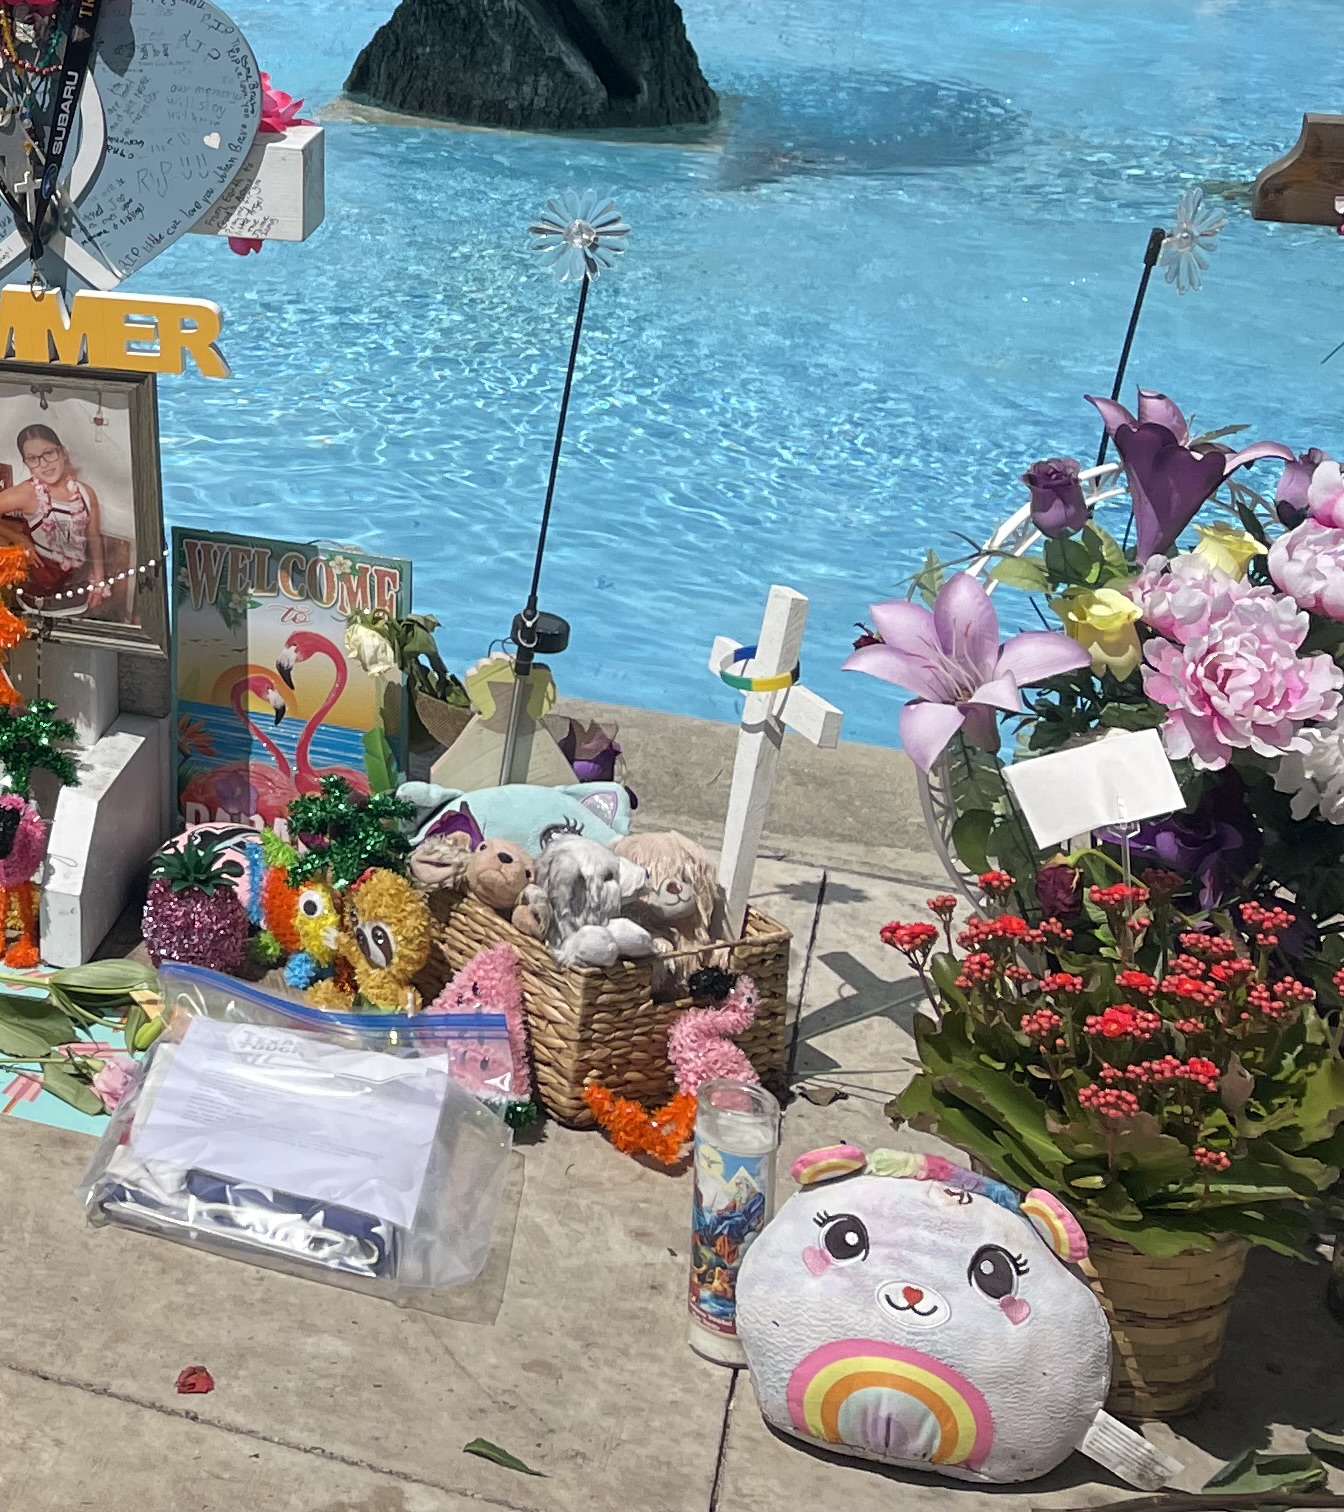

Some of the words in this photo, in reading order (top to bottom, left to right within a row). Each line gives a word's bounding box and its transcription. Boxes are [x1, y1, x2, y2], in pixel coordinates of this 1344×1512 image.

[52, 70, 79, 156] SUBARU
[183, 538, 400, 619] WELCOME
[268, 604, 313, 625] to
